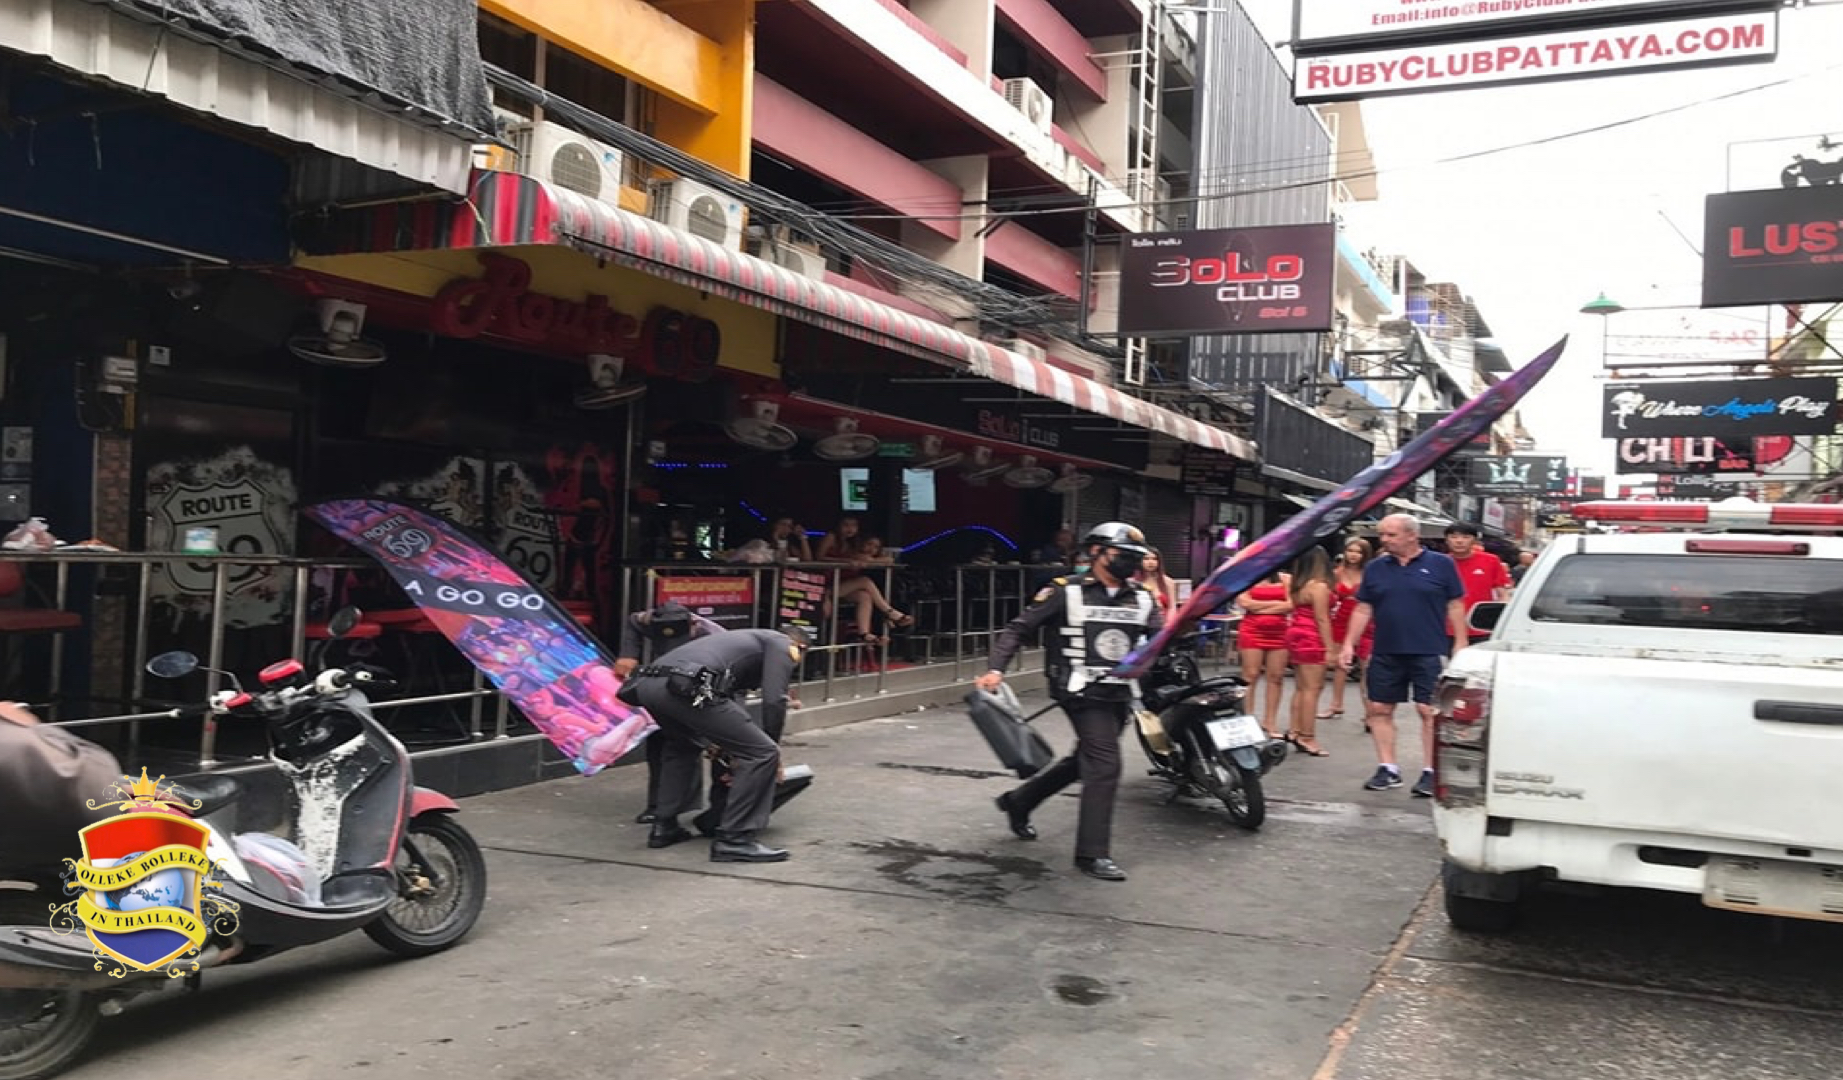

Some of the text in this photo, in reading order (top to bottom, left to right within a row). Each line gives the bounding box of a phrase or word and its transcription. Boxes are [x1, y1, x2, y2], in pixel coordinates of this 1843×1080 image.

[1306, 24, 1765, 90] RUBYCLUBPATTAYA.COM
[1728, 220, 1843, 258] LUS
[1216, 283, 1301, 302] CLUB
[181, 493, 252, 517] ROUTE
[363, 516, 408, 541] ROUTE
[382, 528, 432, 558] 69
[404, 580, 545, 611] A GO GO
